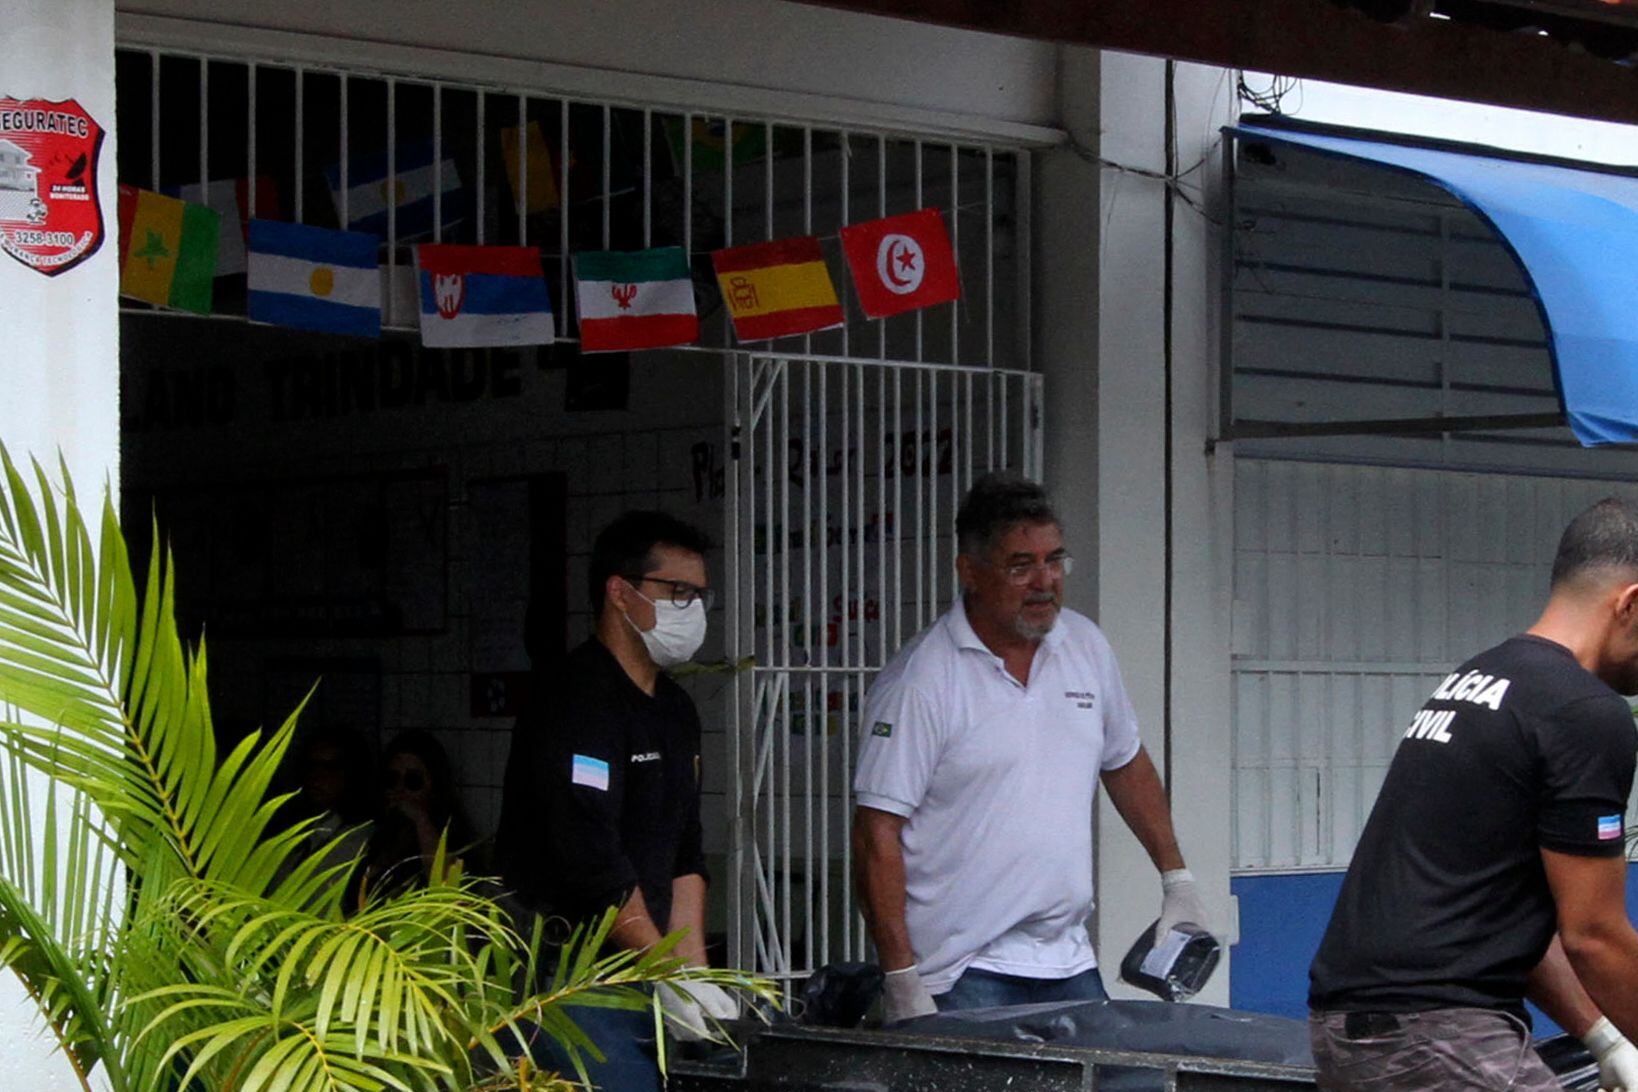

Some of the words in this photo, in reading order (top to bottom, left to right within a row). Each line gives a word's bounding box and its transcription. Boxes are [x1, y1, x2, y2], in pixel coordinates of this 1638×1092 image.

[0, 112, 86, 137] EGURATEC
[16, 231, 73, 245] 3258-3100
[1430, 669, 1510, 711] LÍCIA
